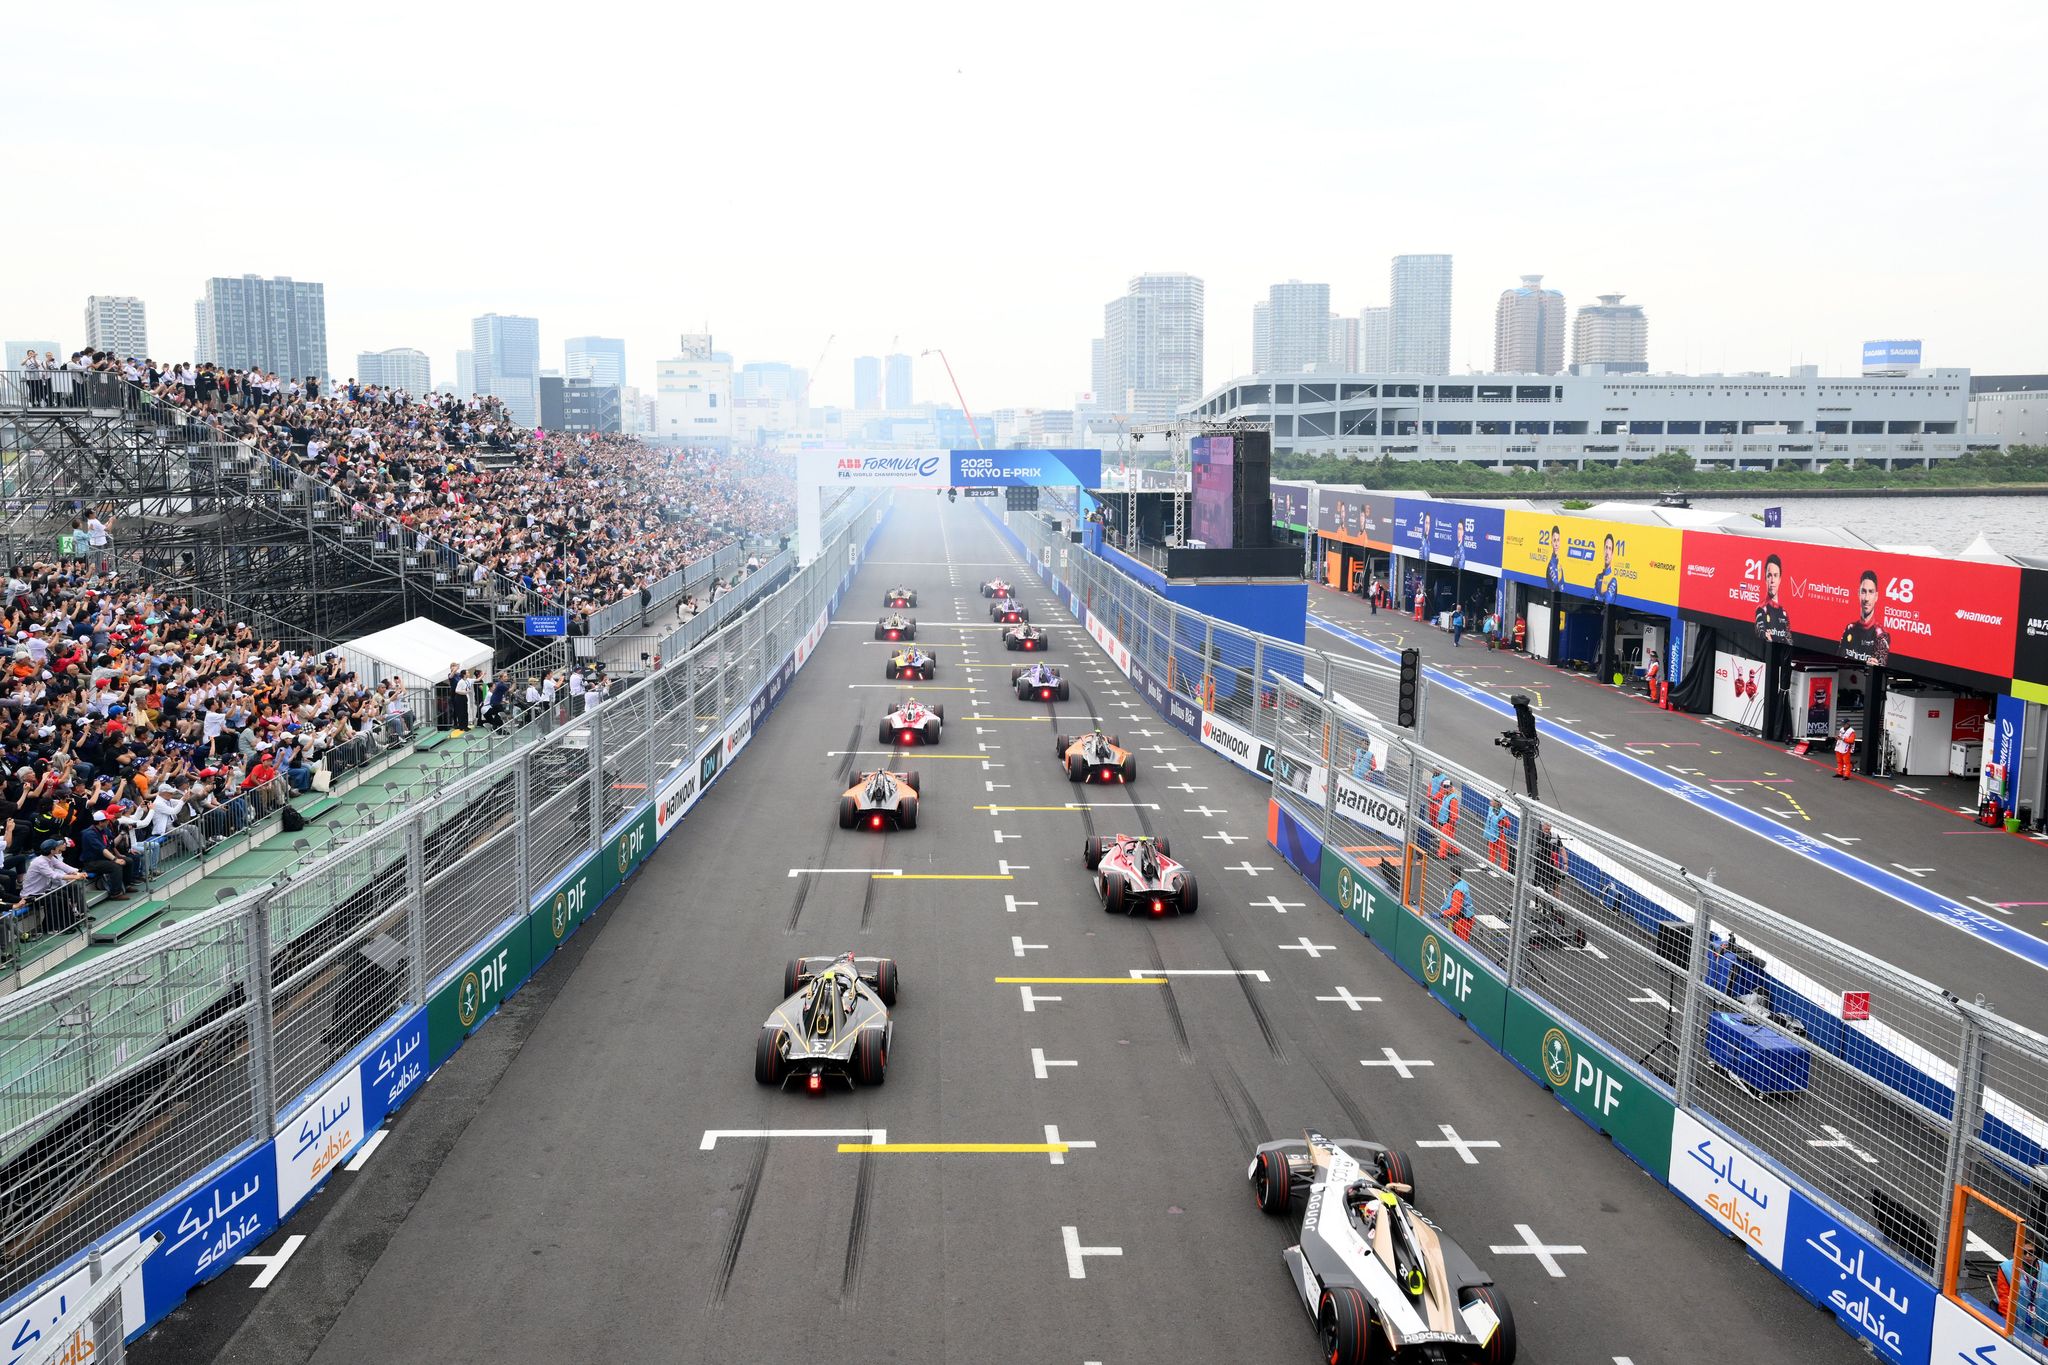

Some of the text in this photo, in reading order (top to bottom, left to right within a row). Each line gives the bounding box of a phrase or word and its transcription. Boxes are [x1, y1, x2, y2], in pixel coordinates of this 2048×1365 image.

[838, 458, 861, 469] ABB
[862, 457, 920, 470] FORMULA
[961, 458, 993, 468] 2025
[961, 468, 1041, 478] TOKYO E-PRIX
[1419, 512, 1424, 525] 2
[1465, 518, 1475, 532] 55
[1464, 541, 1477, 550] HUGHES
[1539, 530, 1550, 545] 22
[1567, 538, 1596, 548] LOLA
[1616, 540, 1625, 556] 11
[1619, 569, 1637, 580] GRASSI
[1745, 559, 1762, 580] 21
[1729, 588, 1760, 603] DE VRIES
[1807, 592, 1830, 601] FORMULA
[1808, 583, 1850, 597] mahindra
[1885, 577, 1914, 603] 48
[1884, 606, 1912, 619] Edoardo
[1883, 615, 1932, 636] MORTARA
[2027, 618, 2042, 629] ABB
[1716, 668, 1728, 678] 48
[1170, 698, 1185, 720] Julius
[630, 822, 645, 860] PIF
[568, 877, 587, 921] PIF
[1353, 881, 1376, 922] PIF
[481, 948, 507, 1003] PIF
[1443, 953, 1474, 1002] PIF
[373, 1031, 420, 1087] سابك
[388, 1063, 421, 1105] sabic
[1574, 1053, 1623, 1117] PIF
[292, 1095, 351, 1162] سابك
[310, 1129, 352, 1180] sabic
[1688, 1140, 1769, 1210] سابك
[165, 1174, 260, 1257] سابك
[1704, 1193, 1764, 1247] sabic
[194, 1212, 261, 1276] sabic
[1806, 1229, 1910, 1315] سابك
[1828, 1289, 1904, 1356] sabic
[1403, 1331, 1467, 1344] Wolfspeed
